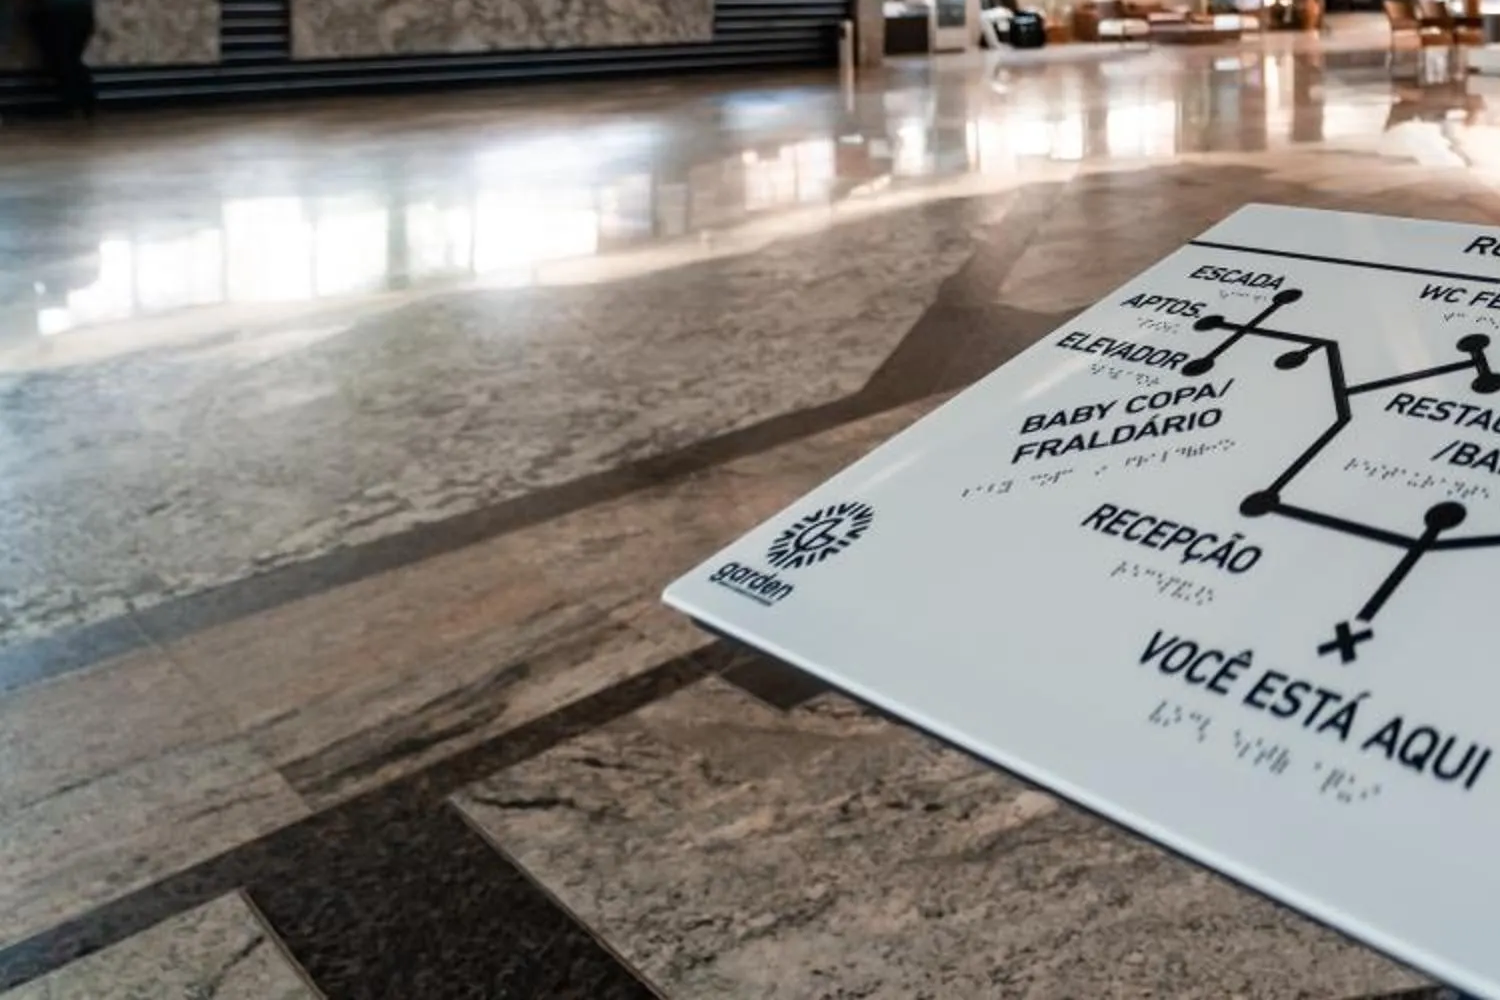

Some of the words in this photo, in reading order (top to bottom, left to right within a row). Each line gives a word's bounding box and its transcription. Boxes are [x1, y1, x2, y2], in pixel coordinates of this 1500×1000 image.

[1188, 265, 1286, 290] ESCADA
[1418, 283, 1467, 303] WC
[1121, 293, 1208, 319] APTOS.
[1056, 331, 1190, 371] ELEVADOR
[1010, 408, 1223, 465] FRALDÁRIO
[1020, 400, 1119, 436] BABY
[1081, 503, 1263, 575] RECEPÇÃO
[708, 562, 795, 602] garden
[1138, 629, 1254, 697] VOCÊ
[1242, 670, 1371, 742] ESTÁ
[1361, 716, 1492, 790] AQUI
